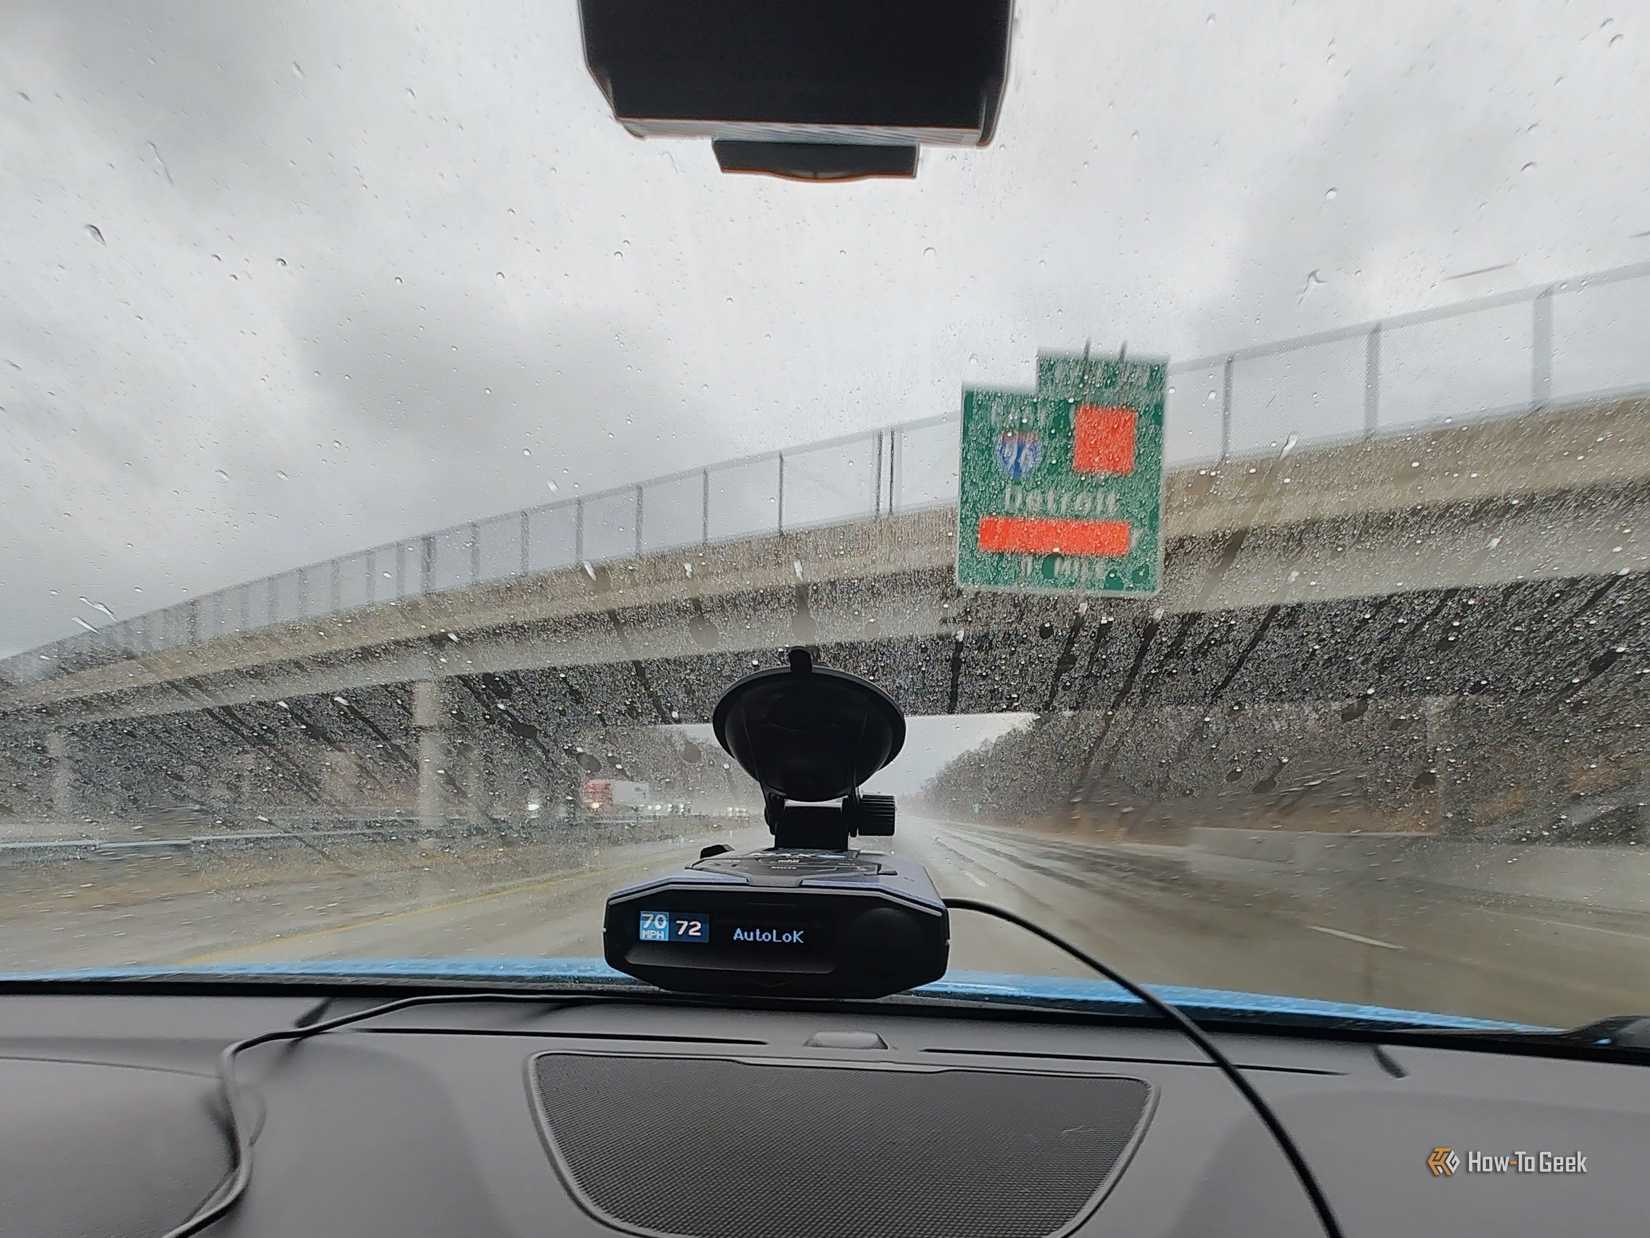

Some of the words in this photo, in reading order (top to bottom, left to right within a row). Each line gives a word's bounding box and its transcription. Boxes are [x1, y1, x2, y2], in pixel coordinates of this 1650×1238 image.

[1004, 485, 1119, 514] Detroit
[641, 913, 667, 929] 70
[676, 920, 702, 936] 72
[733, 928, 804, 944] AutoLoK
[642, 930, 665, 939] MPH
